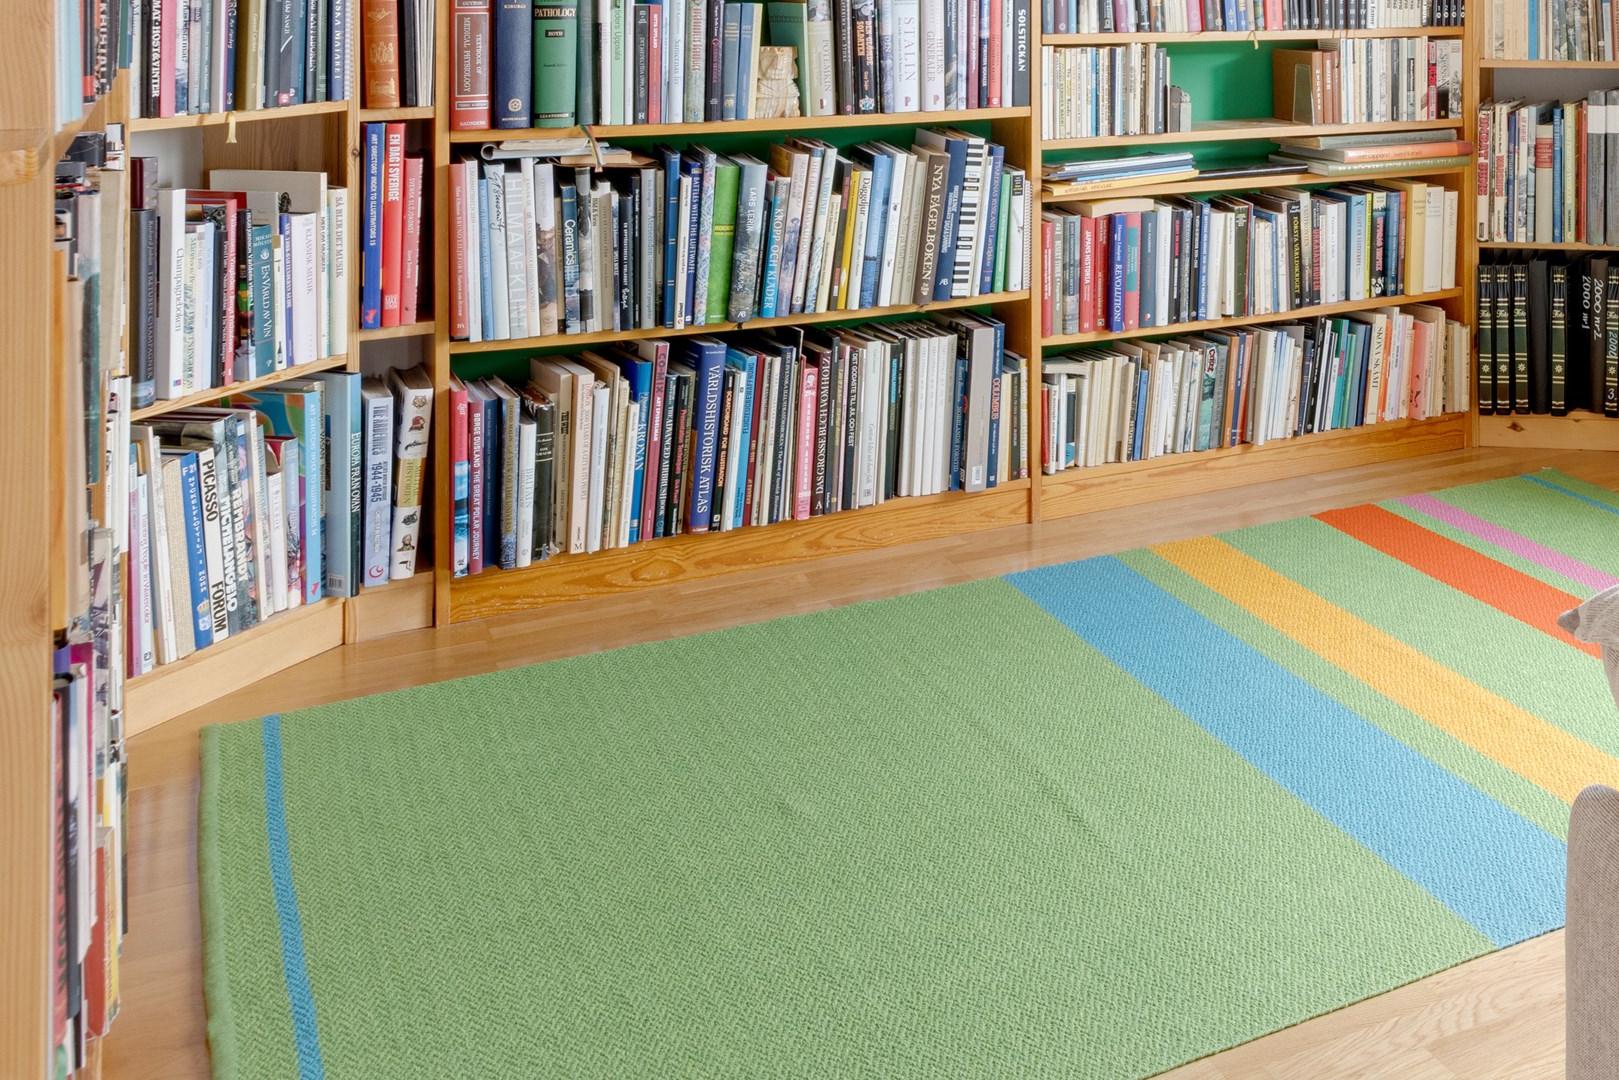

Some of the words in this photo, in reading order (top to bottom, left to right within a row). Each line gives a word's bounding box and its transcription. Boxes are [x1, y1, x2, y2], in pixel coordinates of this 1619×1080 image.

[463, 17, 471, 48] MEDICAL
[904, 16, 916, 81] STALIN
[1017, 9, 1026, 72] SOLSTICKAN
[747, 187, 757, 208] LARS
[929, 164, 944, 191] NYA
[505, 177, 523, 243] HILMA
[563, 219, 576, 265] Ceramics
[921, 193, 940, 281] FÅGELBOKEN
[1114, 264, 1122, 322] REVOLUTION!
[472, 470, 481, 483] THE
[472, 484, 481, 506] GREAT
[696, 475, 712, 514] ATLAS
[471, 507, 481, 528] POLAR
[202, 459, 217, 522] PICASSO
[212, 582, 226, 633] FORUM
